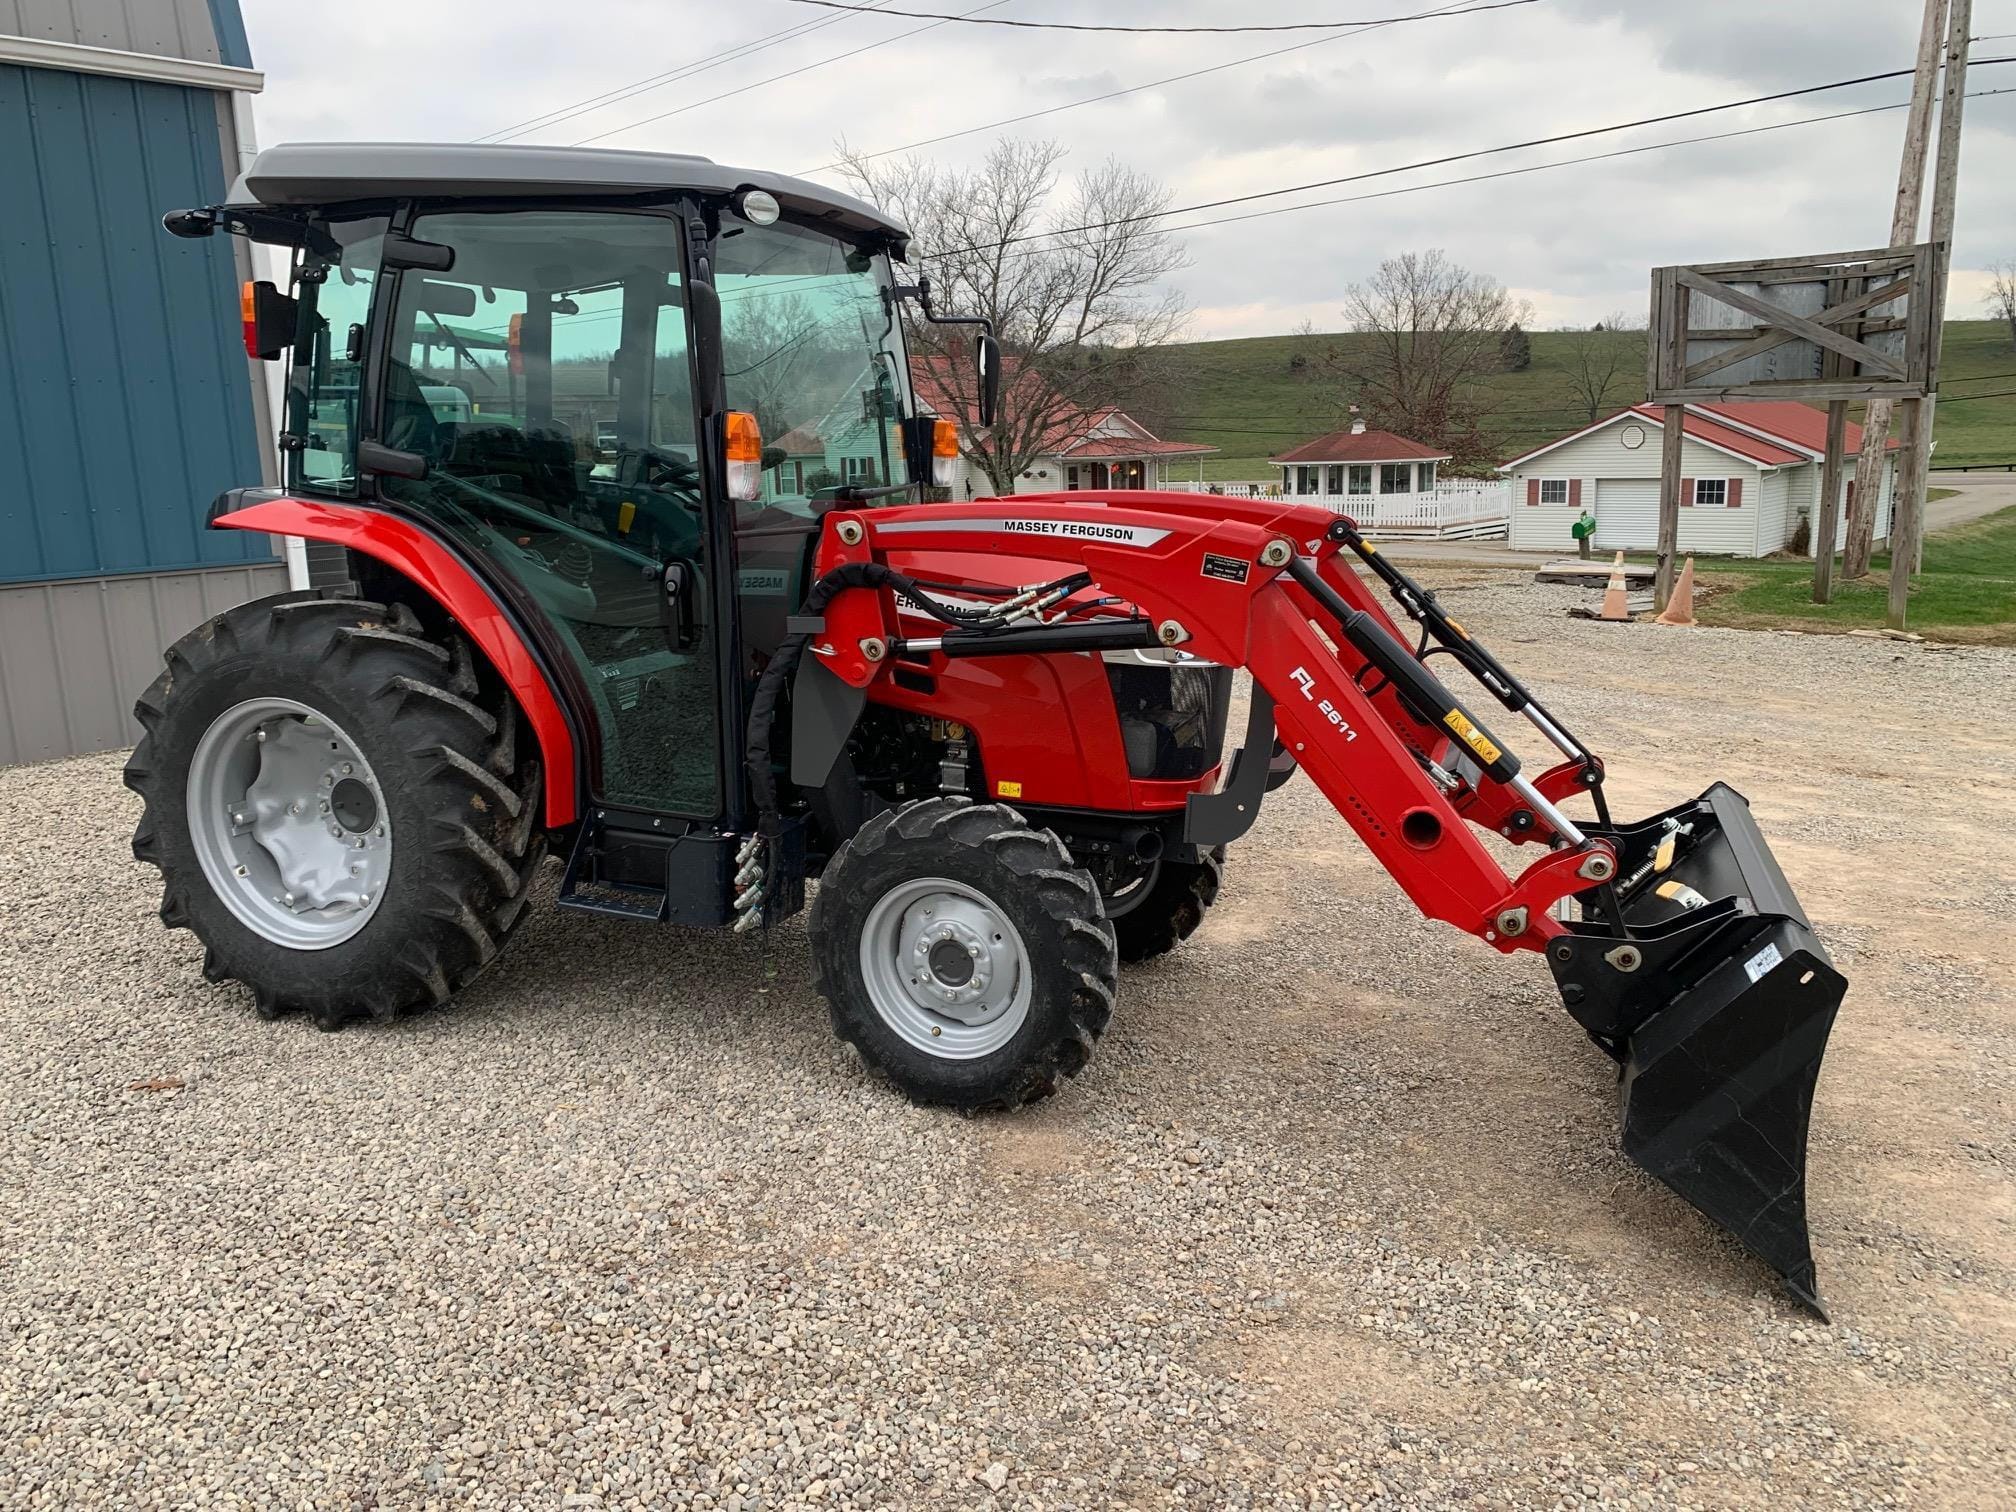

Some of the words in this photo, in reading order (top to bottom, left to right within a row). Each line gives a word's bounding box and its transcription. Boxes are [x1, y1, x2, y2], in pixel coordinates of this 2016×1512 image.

[1004, 521, 1058, 534] MASSEY
[1062, 524, 1134, 540] FERGUSON
[1289, 666, 1316, 701] FL
[1317, 699, 1358, 742] 2611
